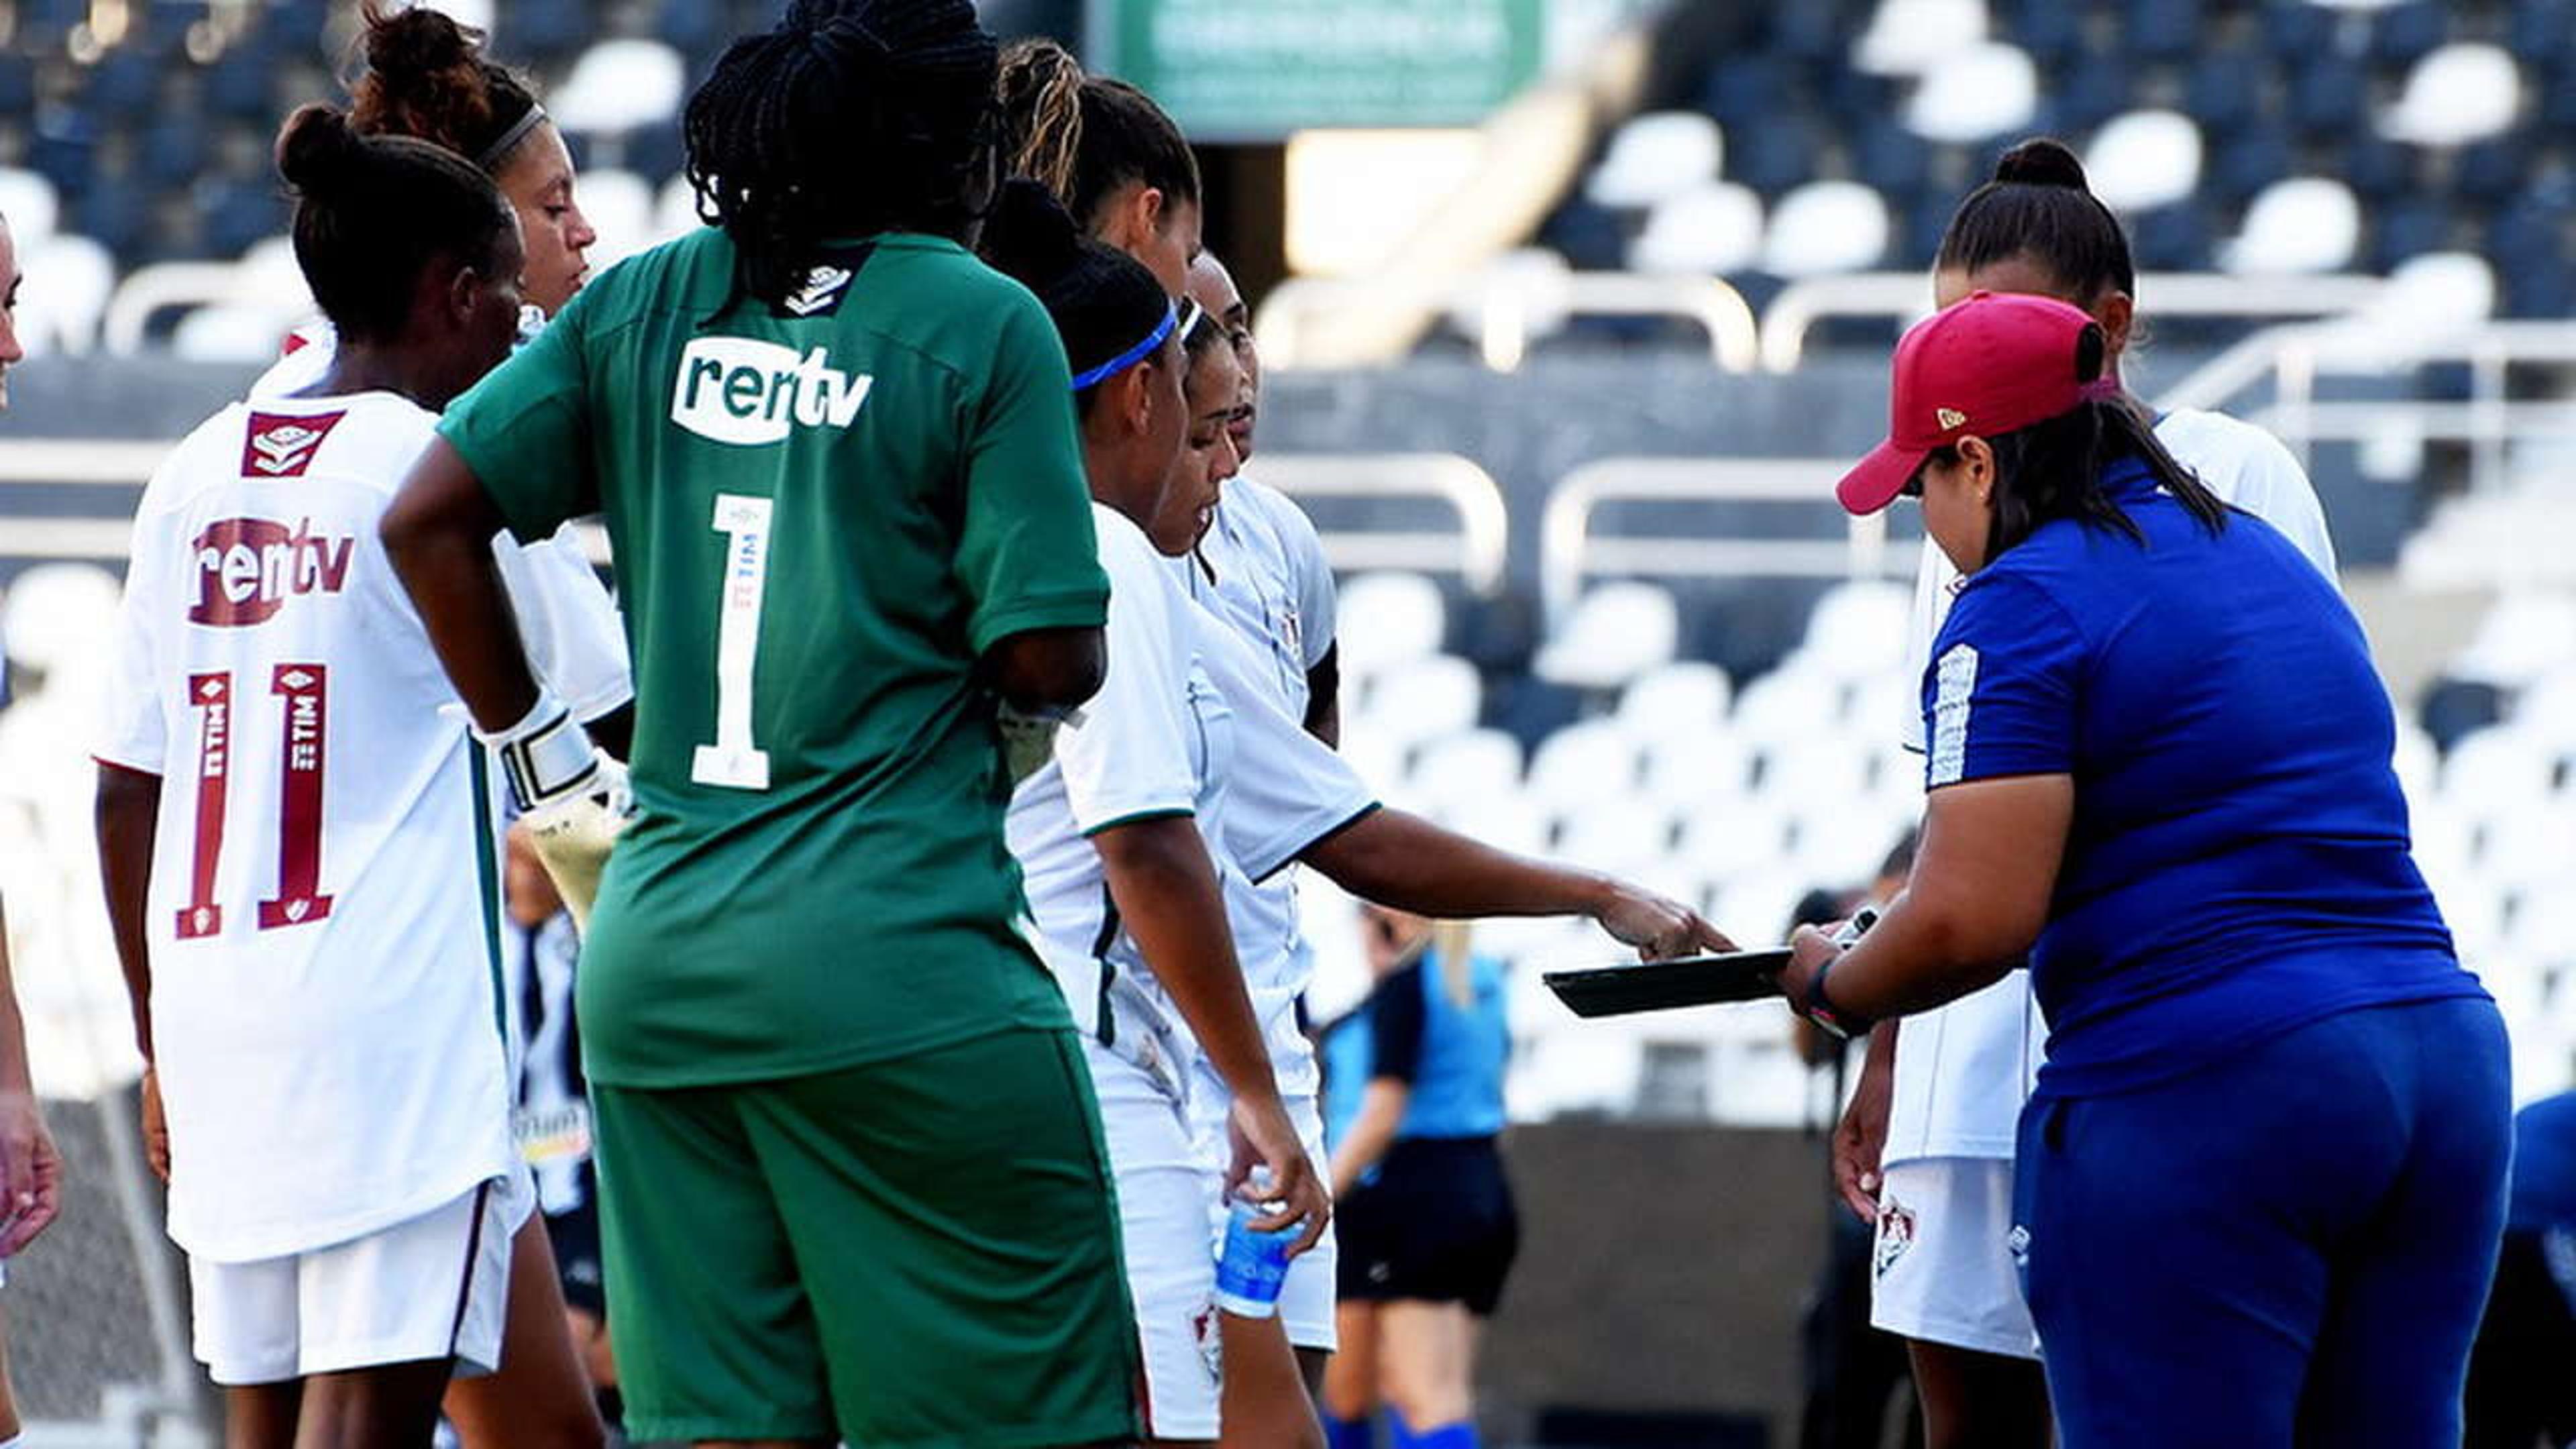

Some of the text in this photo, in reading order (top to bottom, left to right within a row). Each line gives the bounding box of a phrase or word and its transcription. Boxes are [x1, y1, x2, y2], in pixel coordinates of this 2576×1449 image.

[739, 533, 757, 578] TIM
[692, 492, 773, 790] 1
[205, 704, 226, 753] TIM
[292, 695, 317, 741] TIM
[176, 663, 334, 940] 11
